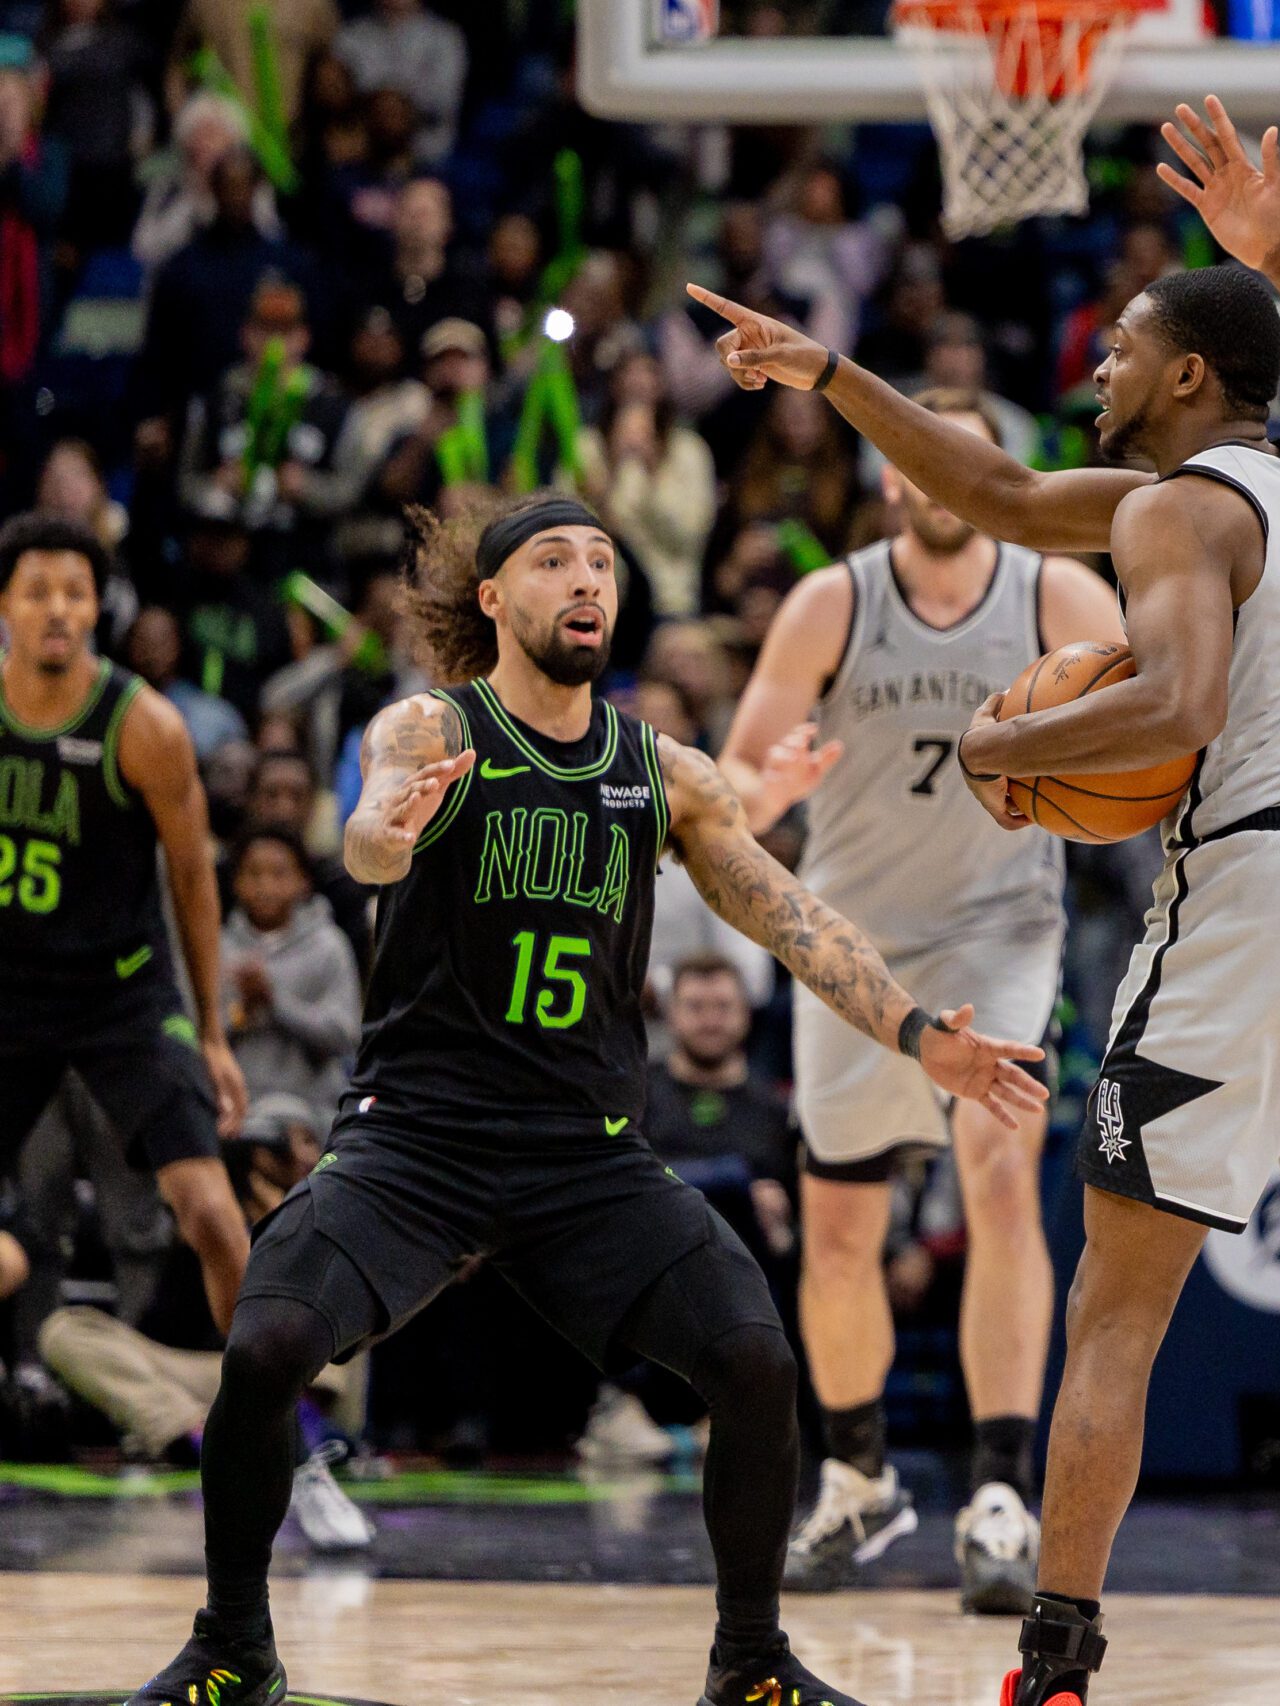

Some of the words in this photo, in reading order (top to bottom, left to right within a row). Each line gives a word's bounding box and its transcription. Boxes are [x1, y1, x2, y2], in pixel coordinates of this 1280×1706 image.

[908, 671, 1000, 711] ANTON
[0, 754, 81, 847] OLA
[600, 783, 651, 799] NEWAGE
[909, 736, 955, 796] 7
[474, 807, 630, 924] NOLA
[505, 931, 592, 1029] 15
